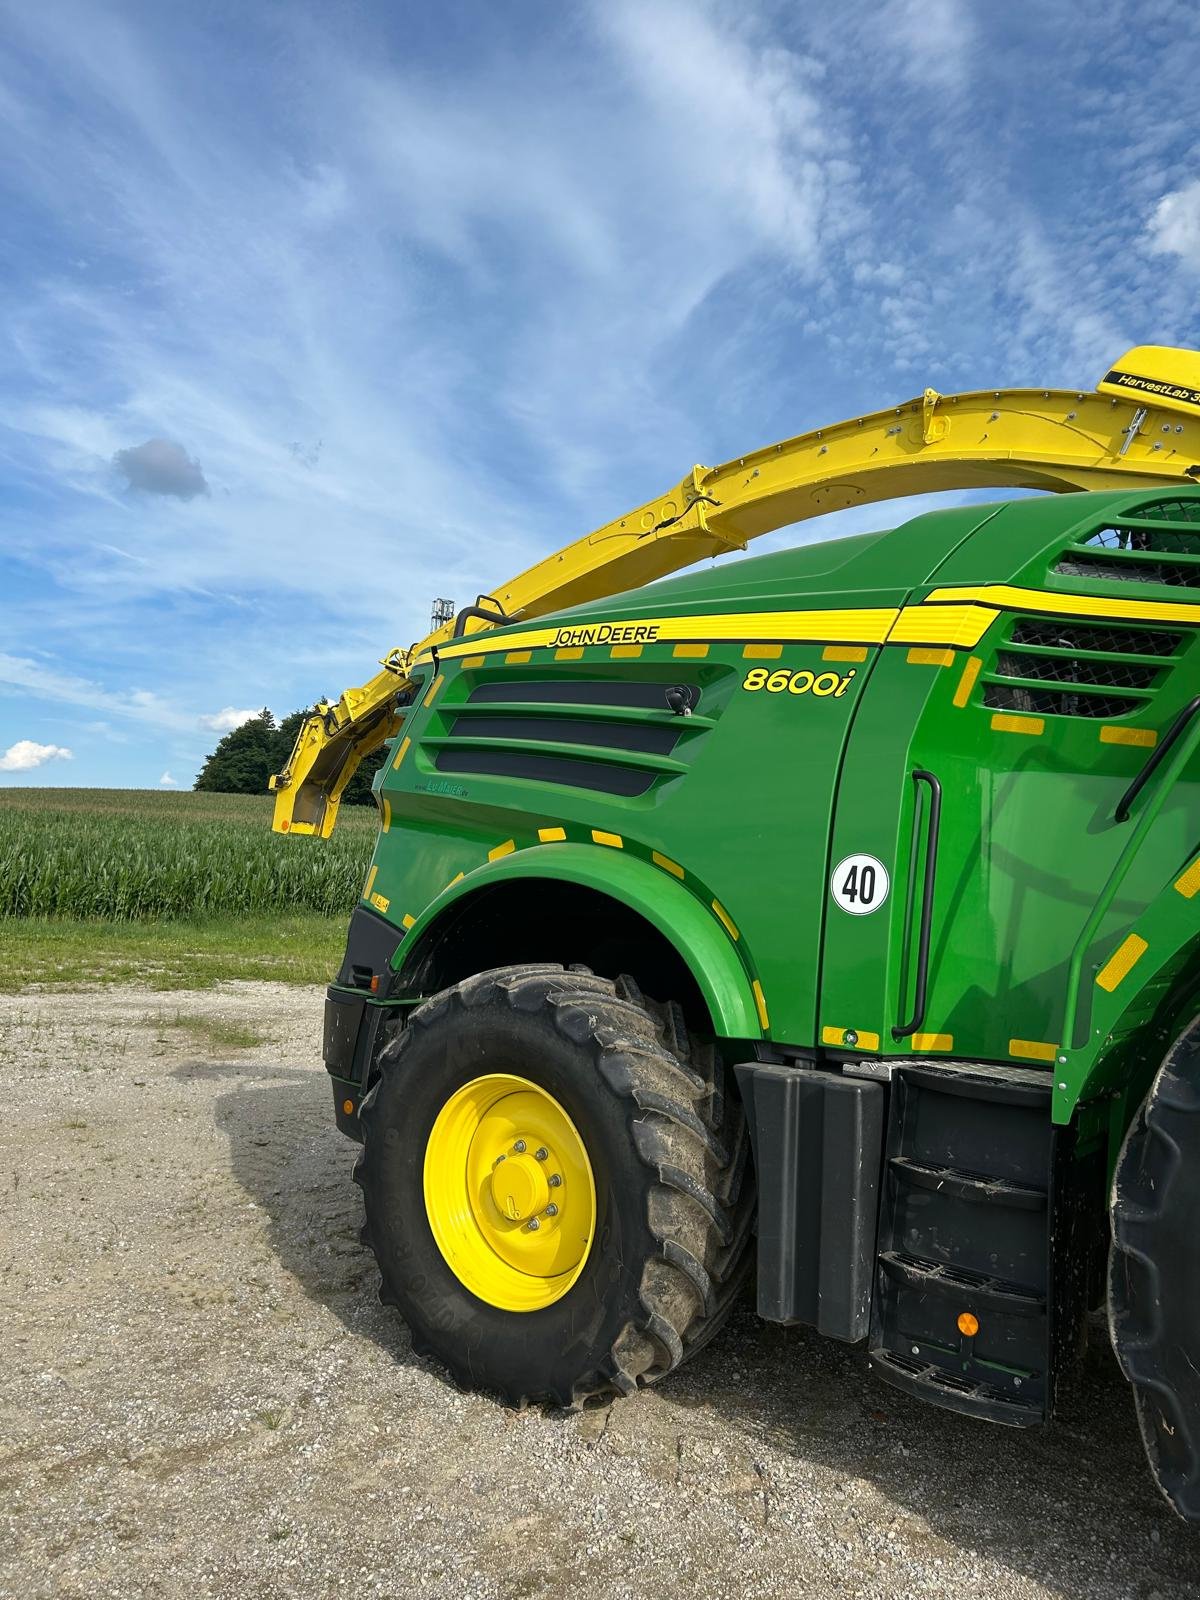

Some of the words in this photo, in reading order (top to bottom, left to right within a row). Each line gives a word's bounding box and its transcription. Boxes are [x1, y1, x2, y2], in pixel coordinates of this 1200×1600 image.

[1118, 375, 1189, 399] HarvestLab
[548, 628, 596, 646] JOHN
[597, 625, 660, 643] DEERE
[742, 667, 856, 698] 8600i
[842, 865, 876, 905] 40
